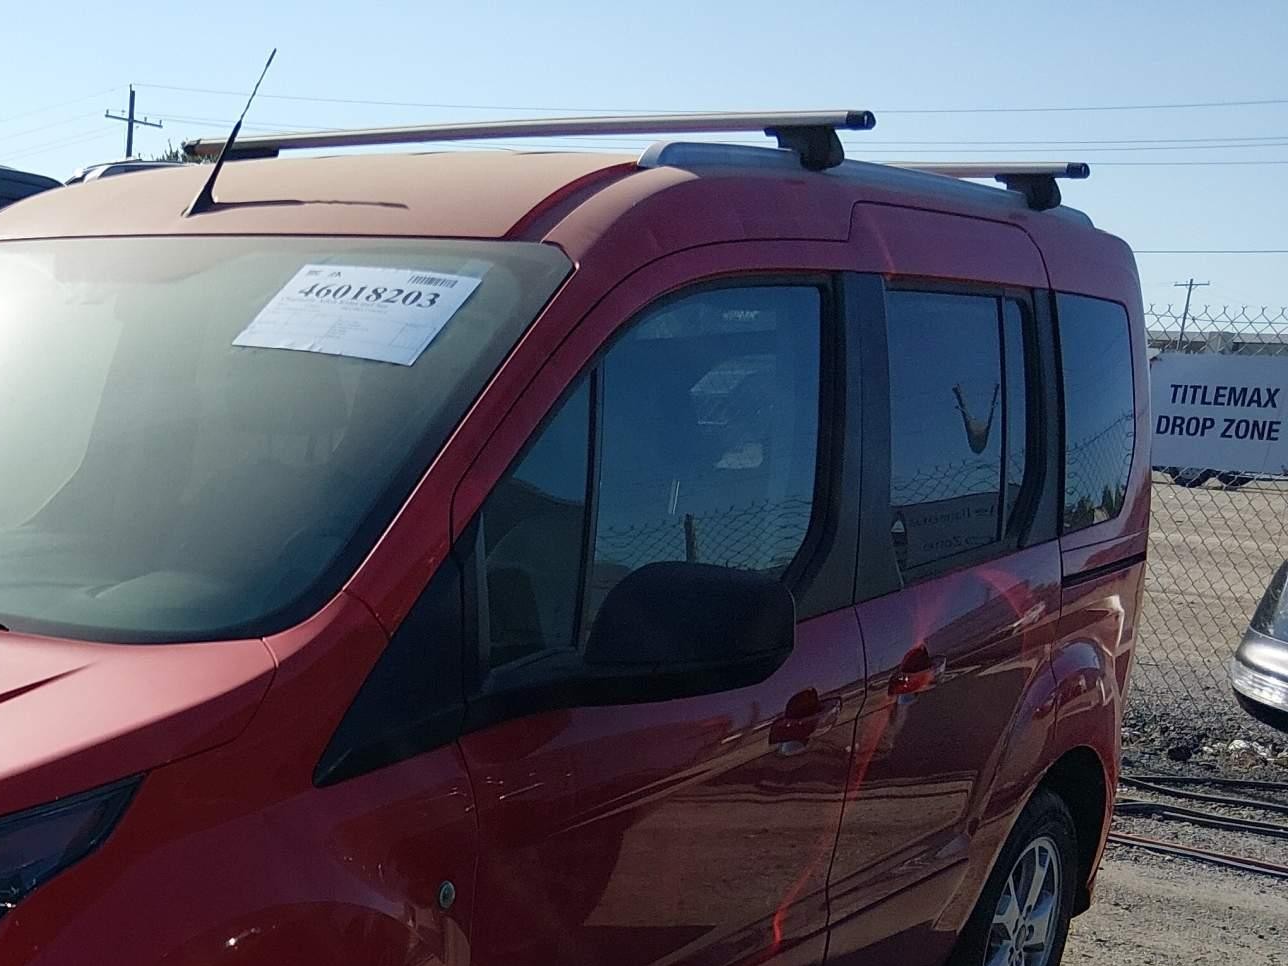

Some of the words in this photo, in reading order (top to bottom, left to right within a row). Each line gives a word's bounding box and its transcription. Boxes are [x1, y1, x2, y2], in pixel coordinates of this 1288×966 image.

[298, 282, 441, 309] 46018203
[1170, 384, 1281, 408] TITLEMAX
[1155, 415, 1215, 437] DROP
[1220, 418, 1282, 441] ZONE
